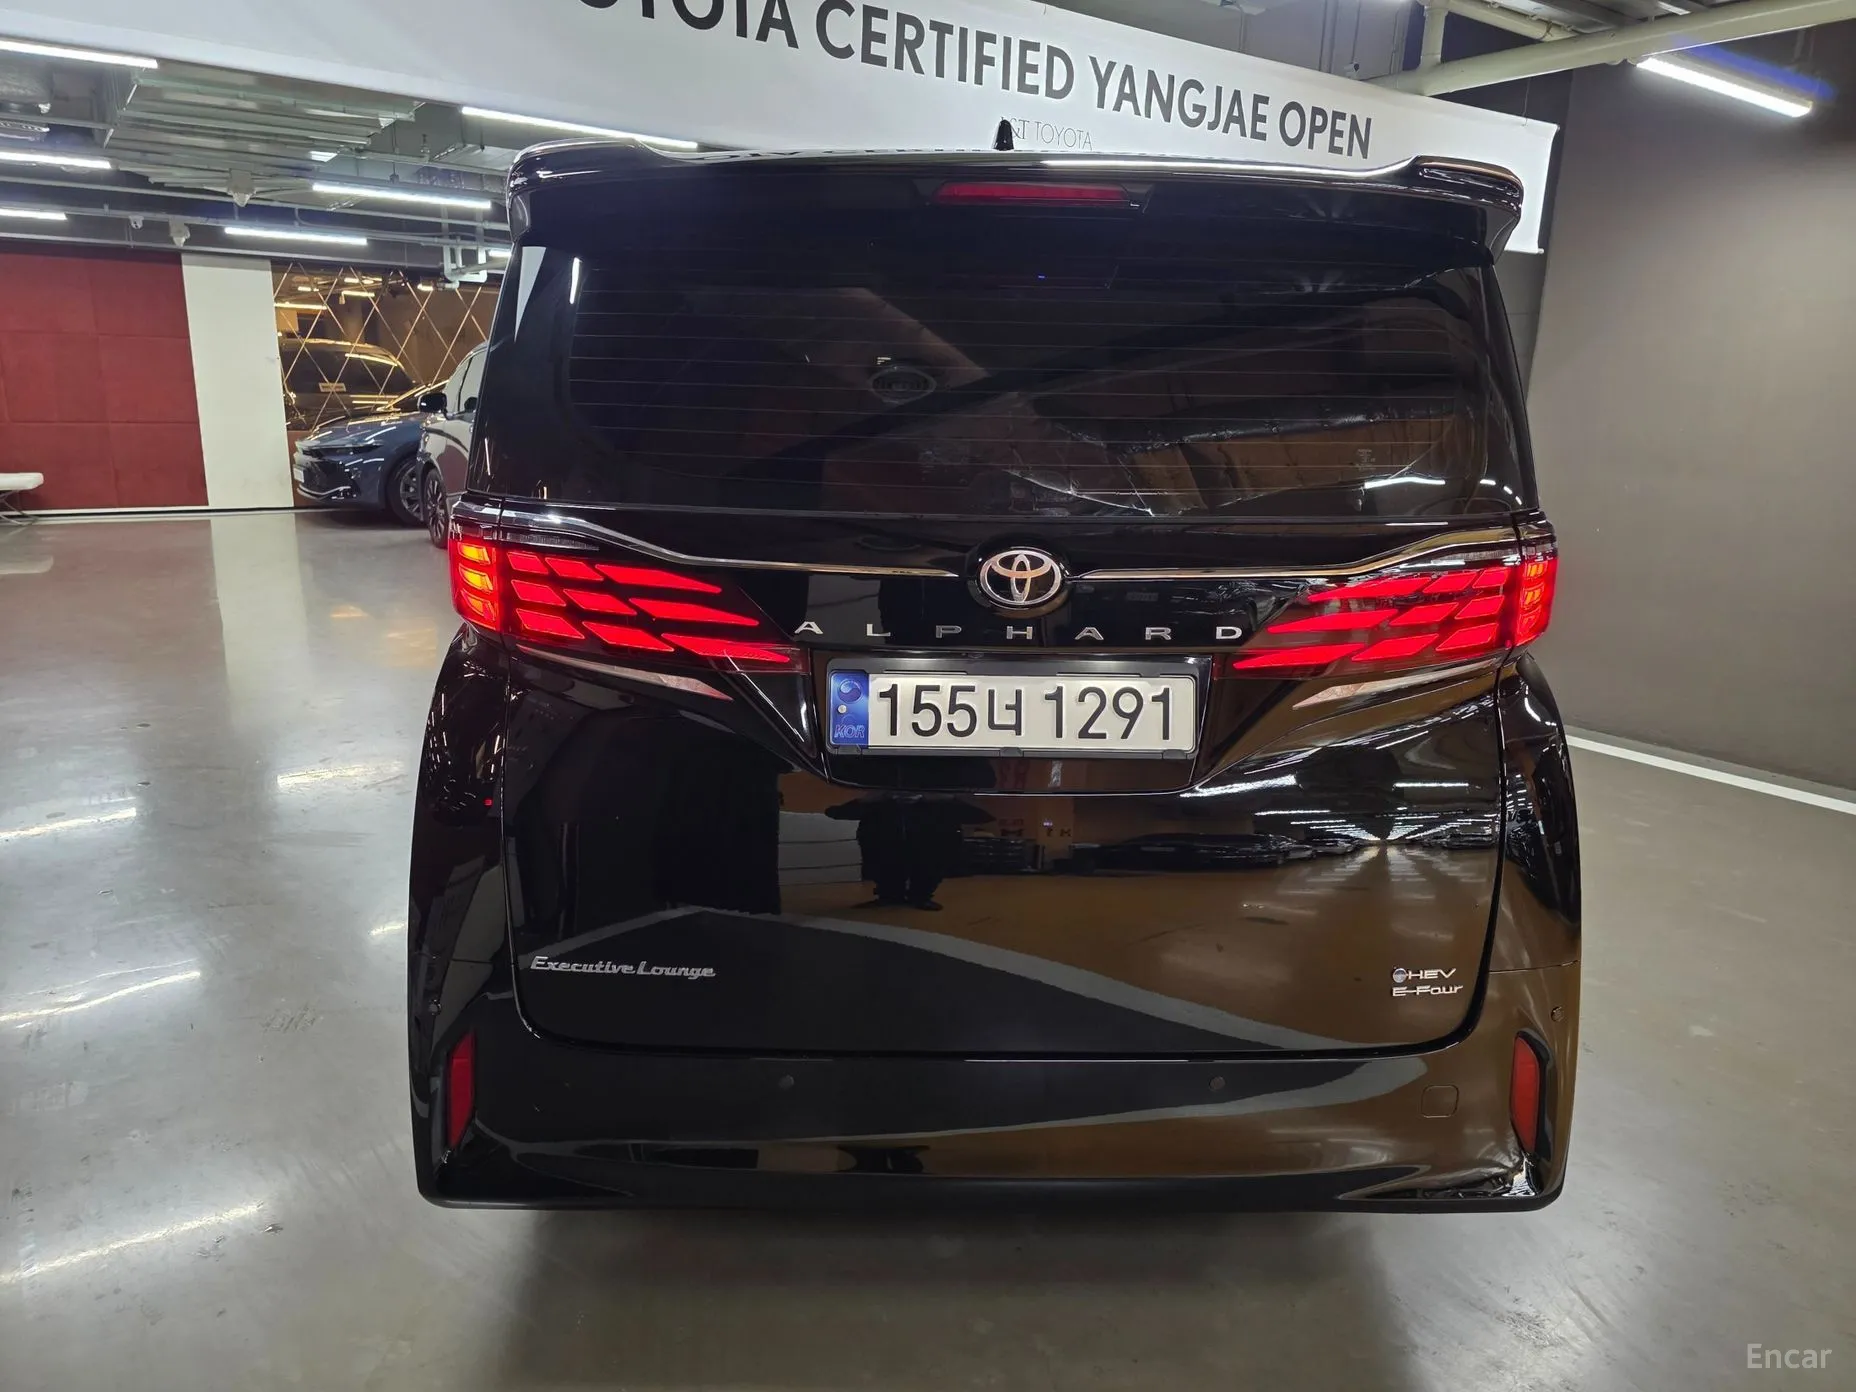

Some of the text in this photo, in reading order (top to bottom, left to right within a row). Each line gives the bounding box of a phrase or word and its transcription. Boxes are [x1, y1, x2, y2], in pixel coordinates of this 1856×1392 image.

[815, 0, 1075, 100] CERTIFIED
[1088, 56, 1271, 142] YANGJAE
[1278, 101, 1372, 160] OPEN
[1034, 121, 1093, 151] TOYOTA
[794, 622, 1243, 641] ALPHARD
[878, 683, 1171, 741] 155너 1291
[834, 724, 865, 739] KOR
[530, 955, 716, 980] Executive Lounge
[1408, 967, 1457, 980] HEV
[1392, 985, 1464, 997] E-Four
